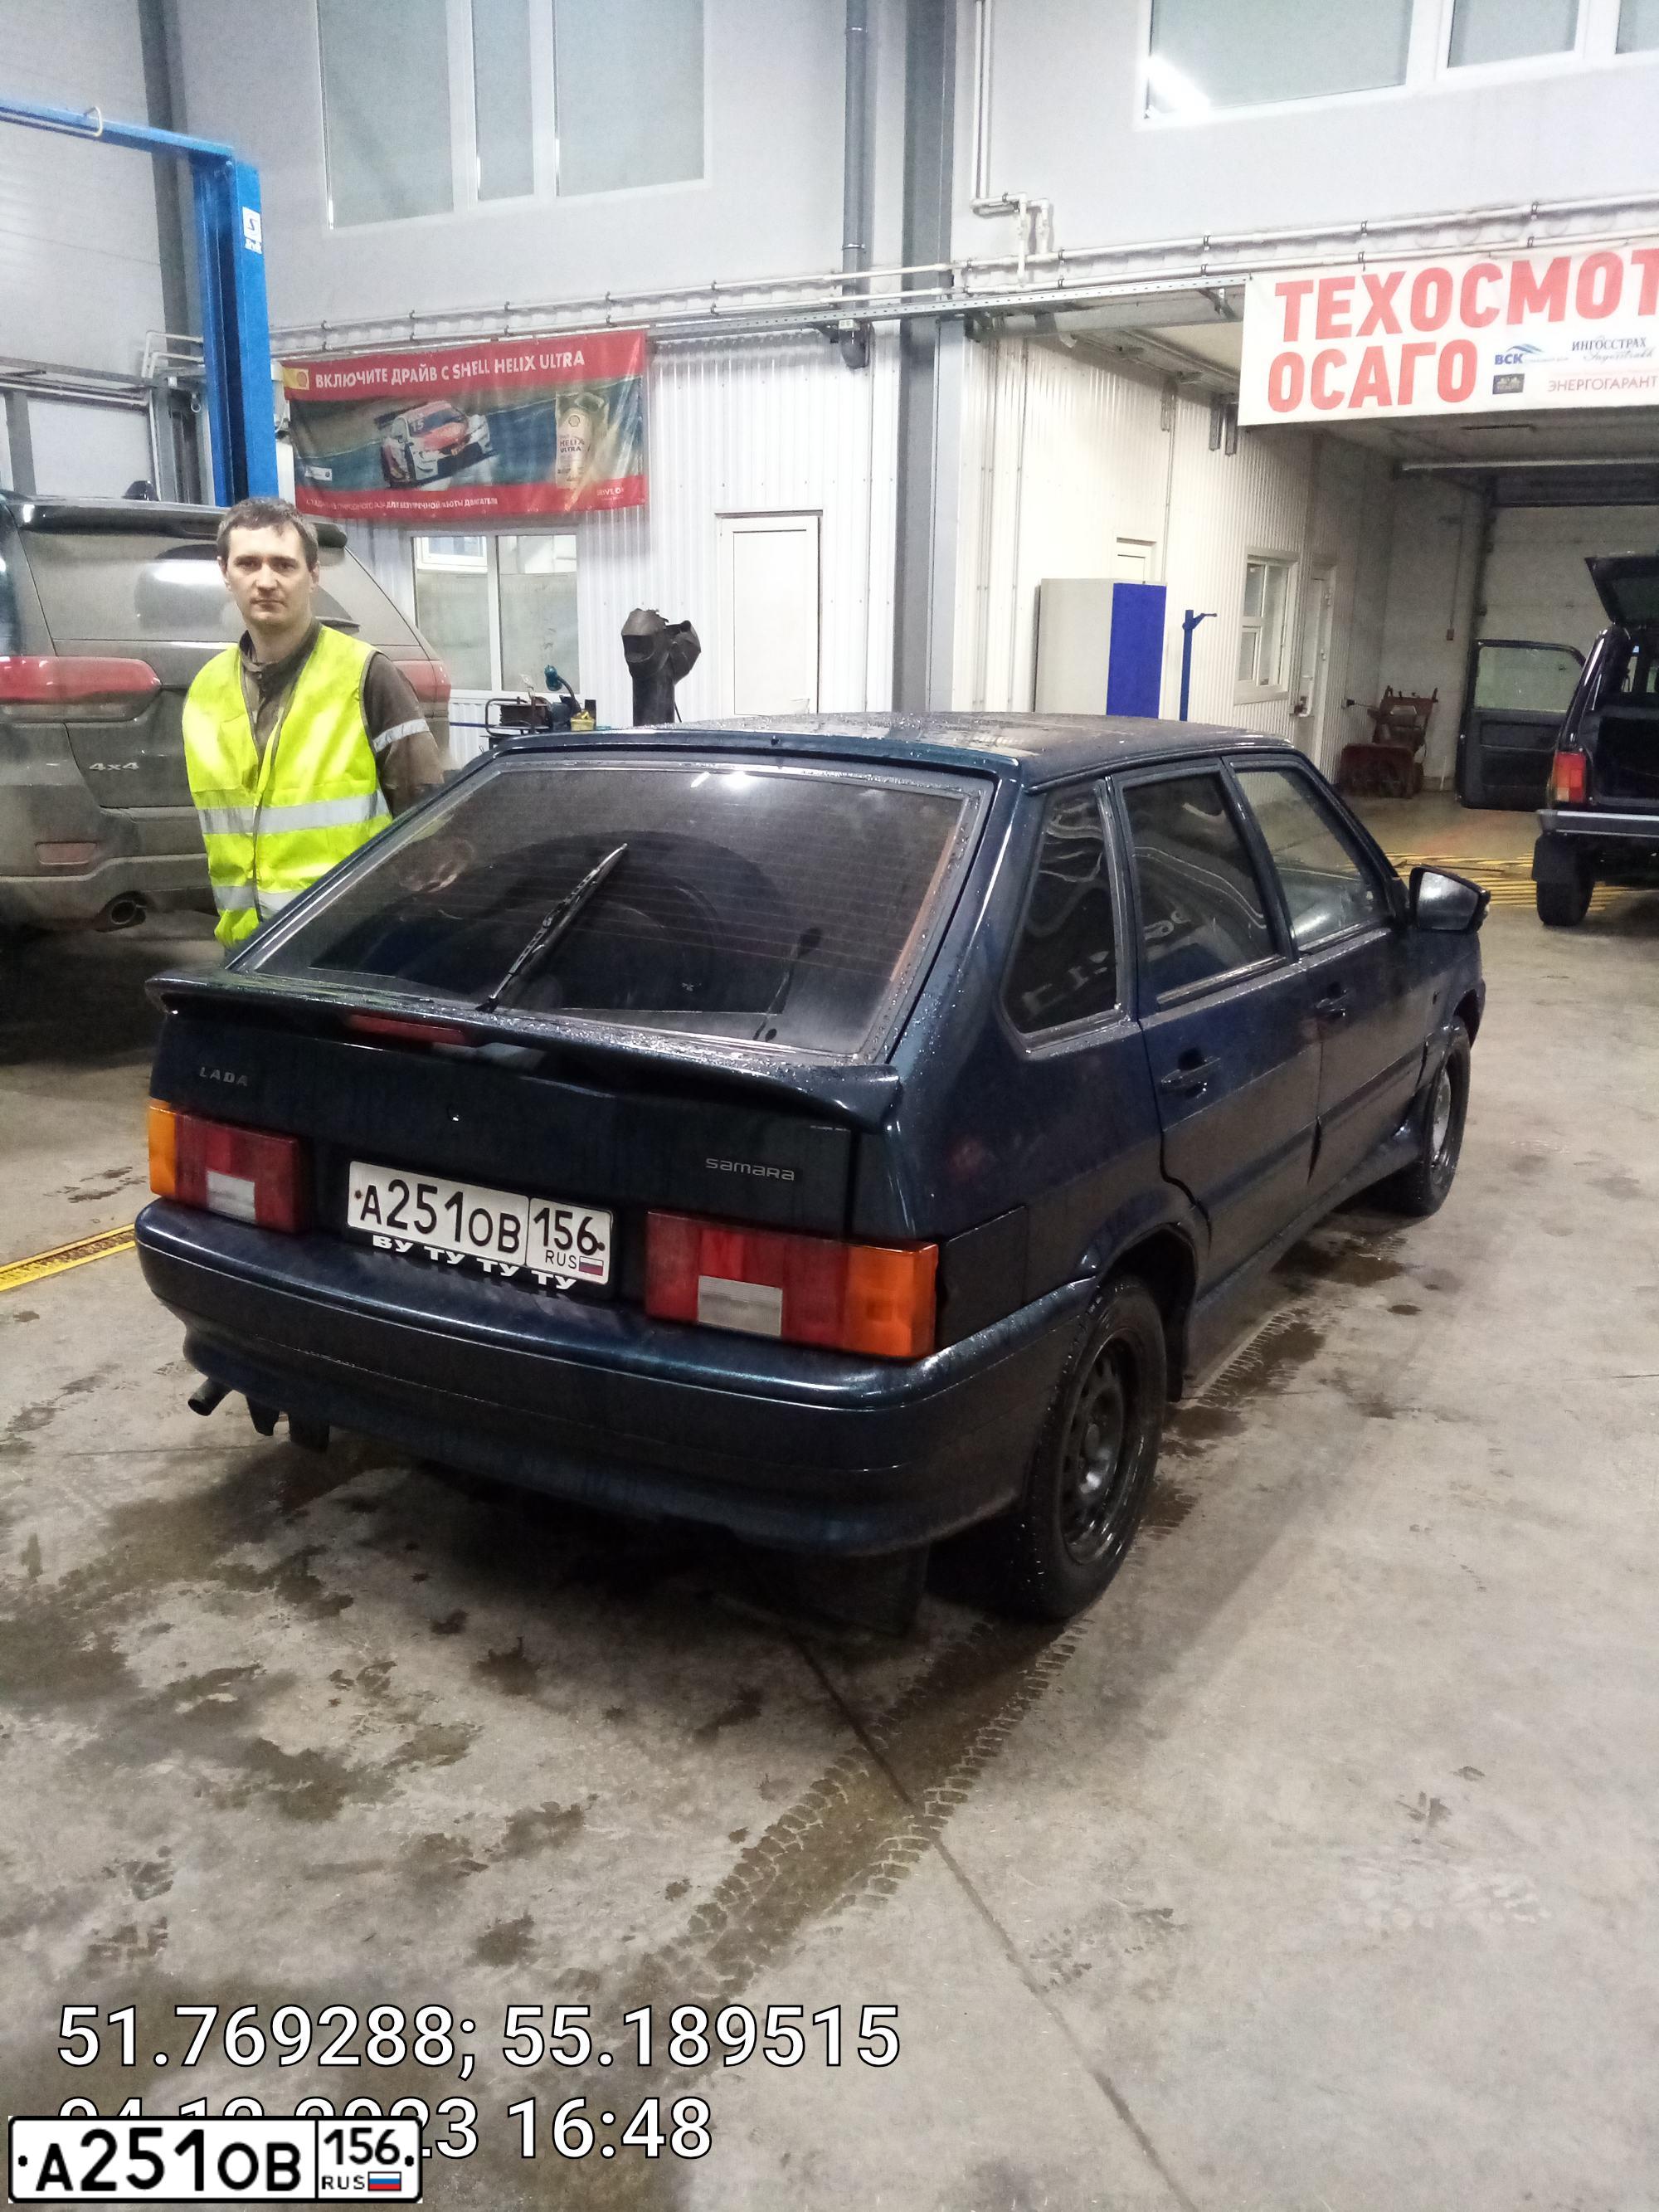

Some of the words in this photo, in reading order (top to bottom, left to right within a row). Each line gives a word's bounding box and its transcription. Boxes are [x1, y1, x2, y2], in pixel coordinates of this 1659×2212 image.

[1275, 248, 1659, 342] ТЕХОСМОТ
[1572, 336, 1647, 352] ИНГОССТРАХ
[315, 367, 389, 389] ВКЛЮЧИТЕ
[391, 363, 438, 385] ДРАЙВ
[452, 362, 490, 380] SHELL
[494, 354, 537, 374] HELIX
[538, 350, 586, 370] ULTRA
[1494, 353, 1524, 365] ВСК
[1268, 339, 1478, 413] ОСАГО
[1547, 375, 1659, 392] ЭНЕРГОГАРАНТ
[89, 762, 140, 772] 4x4
[198, 1066, 249, 1088] LADA
[533, 1206, 601, 1257] 156
[545, 1249, 578, 1270] RUS
